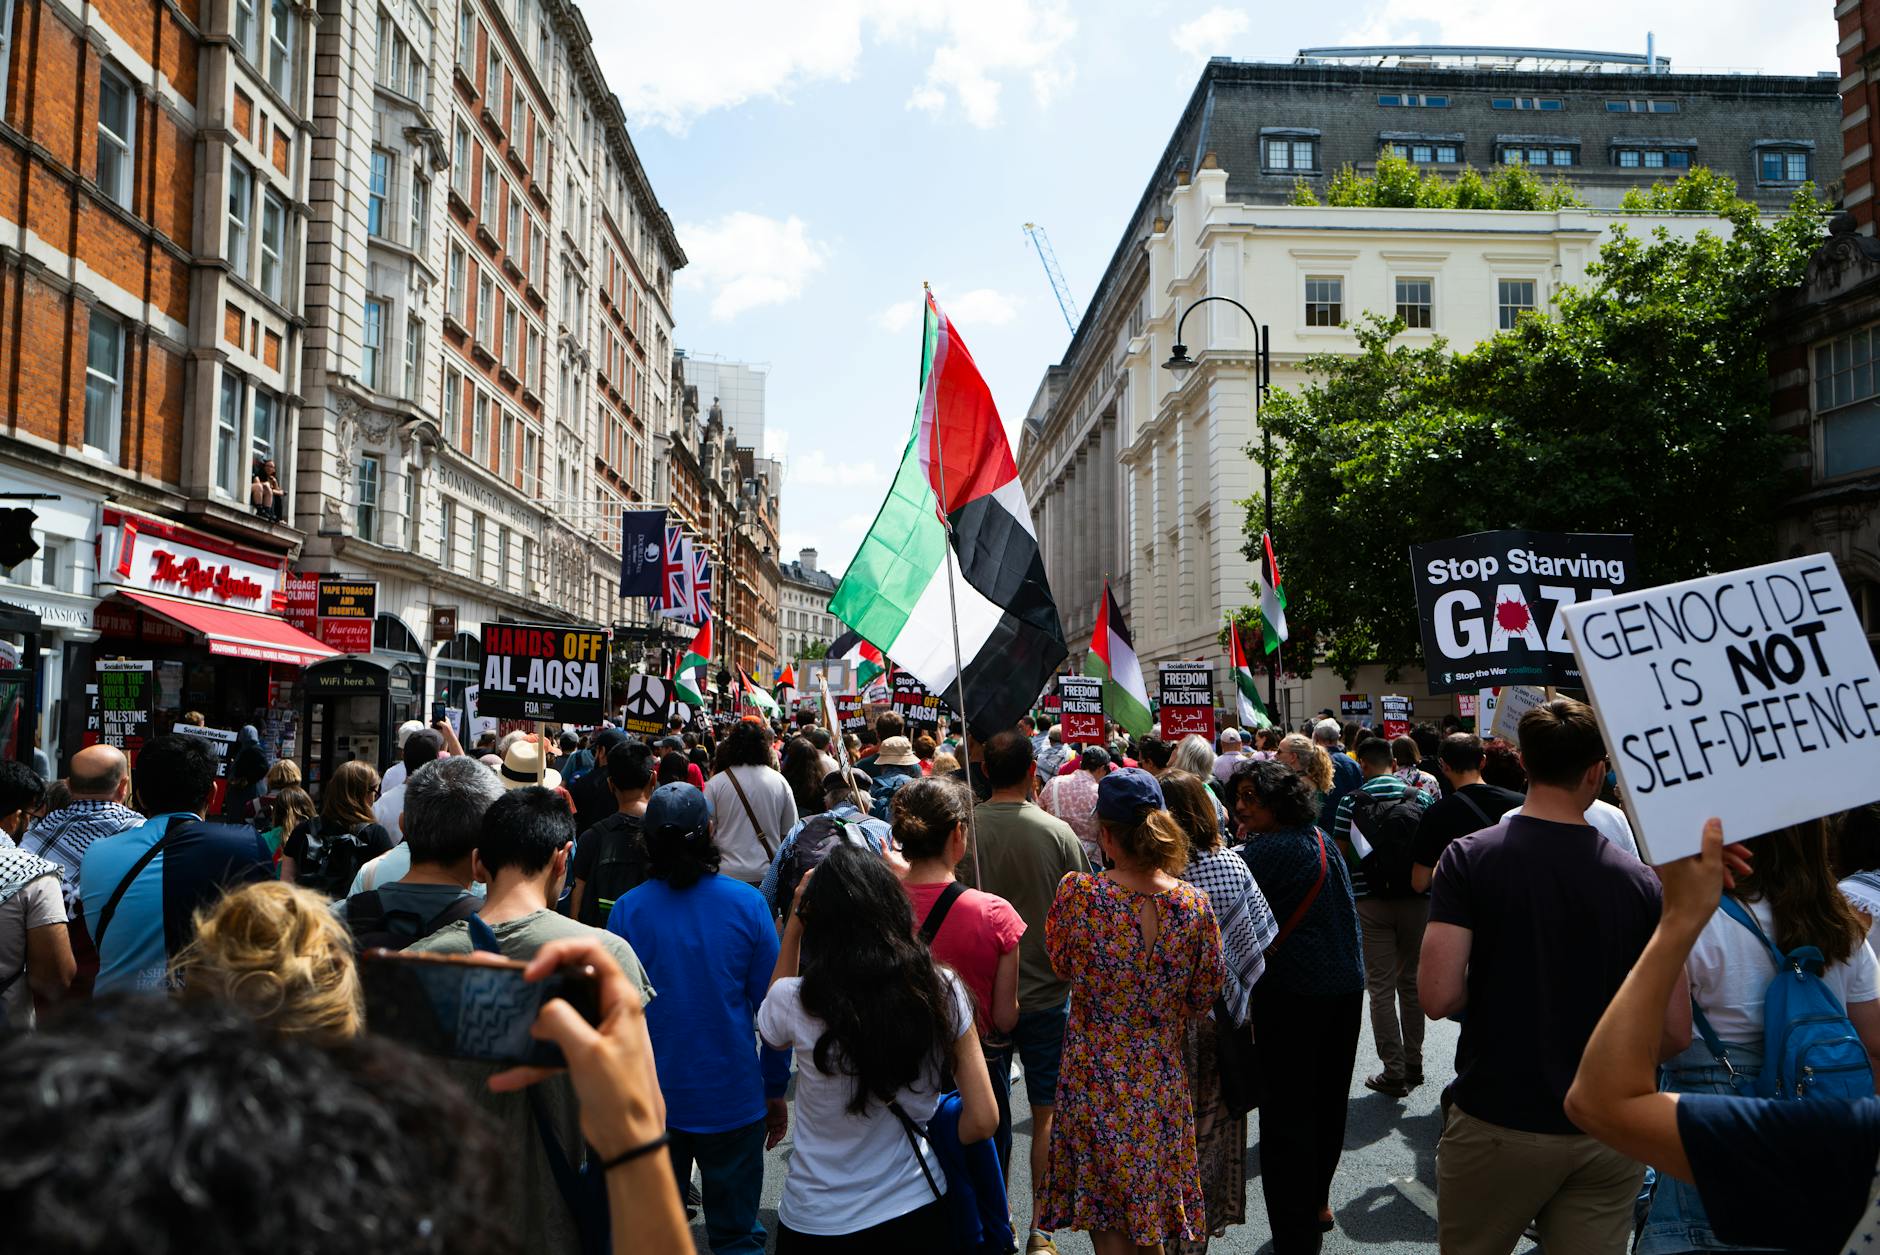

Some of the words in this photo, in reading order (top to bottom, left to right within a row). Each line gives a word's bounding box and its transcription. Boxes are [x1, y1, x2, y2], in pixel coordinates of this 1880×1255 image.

[439, 463, 505, 516] BONNINGTON
[510, 505, 536, 535] HOTEL
[151, 549, 184, 583] The
[180, 556, 215, 594] Red
[1427, 555, 1500, 585] Stop
[1506, 548, 1626, 585] Starving
[286, 590, 316, 601] OLDING
[322, 585, 341, 595] VAPE
[341, 585, 374, 596] TOBACCO
[340, 596, 355, 605] AND
[40, 605, 88, 625] MANSIONS
[295, 608, 315, 617] HOUR
[328, 606, 366, 616] ESSENTIAL
[1582, 565, 1843, 660] GENOCIDE
[325, 621, 368, 635] Souvenirs
[1433, 583, 1615, 660] GAZ
[486, 626, 556, 657] HANDS
[563, 632, 603, 661] OFF
[1649, 657, 1703, 710] IS
[1725, 620, 1830, 695] NOT
[102, 672, 124, 685] FROM
[127, 672, 145, 685] THE
[483, 654, 600, 699] AL-AQSA
[1164, 672, 1208, 686] FREEDOM
[1455, 671, 1475, 681] Stop
[1475, 669, 1490, 678] the
[1489, 667, 1507, 676] War
[1508, 666, 1543, 675] coalition
[319, 677, 340, 686] WiFi
[343, 677, 364, 686] here
[895, 677, 915, 686] Stop
[102, 685, 126, 698] RIVER
[128, 686, 140, 698] TO
[1063, 685, 1099, 697] FREEDOM
[104, 698, 119, 710] THE
[120, 698, 135, 710] SEA
[893, 692, 923, 706] HANDS
[924, 695, 940, 708] OFF
[1163, 691, 1211, 705] PALESTINE
[524, 702, 539, 714] FOA
[893, 704, 938, 721] AL-AQSA
[1062, 701, 1102, 713] PALESTINE
[104, 710, 147, 723] PALESTINE
[839, 717, 867, 729] L-AQSA
[1070, 716, 1096, 728] الحرية
[1171, 710, 1203, 723] الحرية
[104, 723, 123, 735] WILL
[125, 723, 136, 736] BE
[183, 726, 208, 736] Socialist
[208, 731, 228, 740] Worker
[1067, 727, 1100, 738] لفلسطين
[1167, 721, 1209, 735] لفلسطين
[104, 735, 125, 748] FREE
[1622, 677, 1880, 794] SELF-DEFENCE
